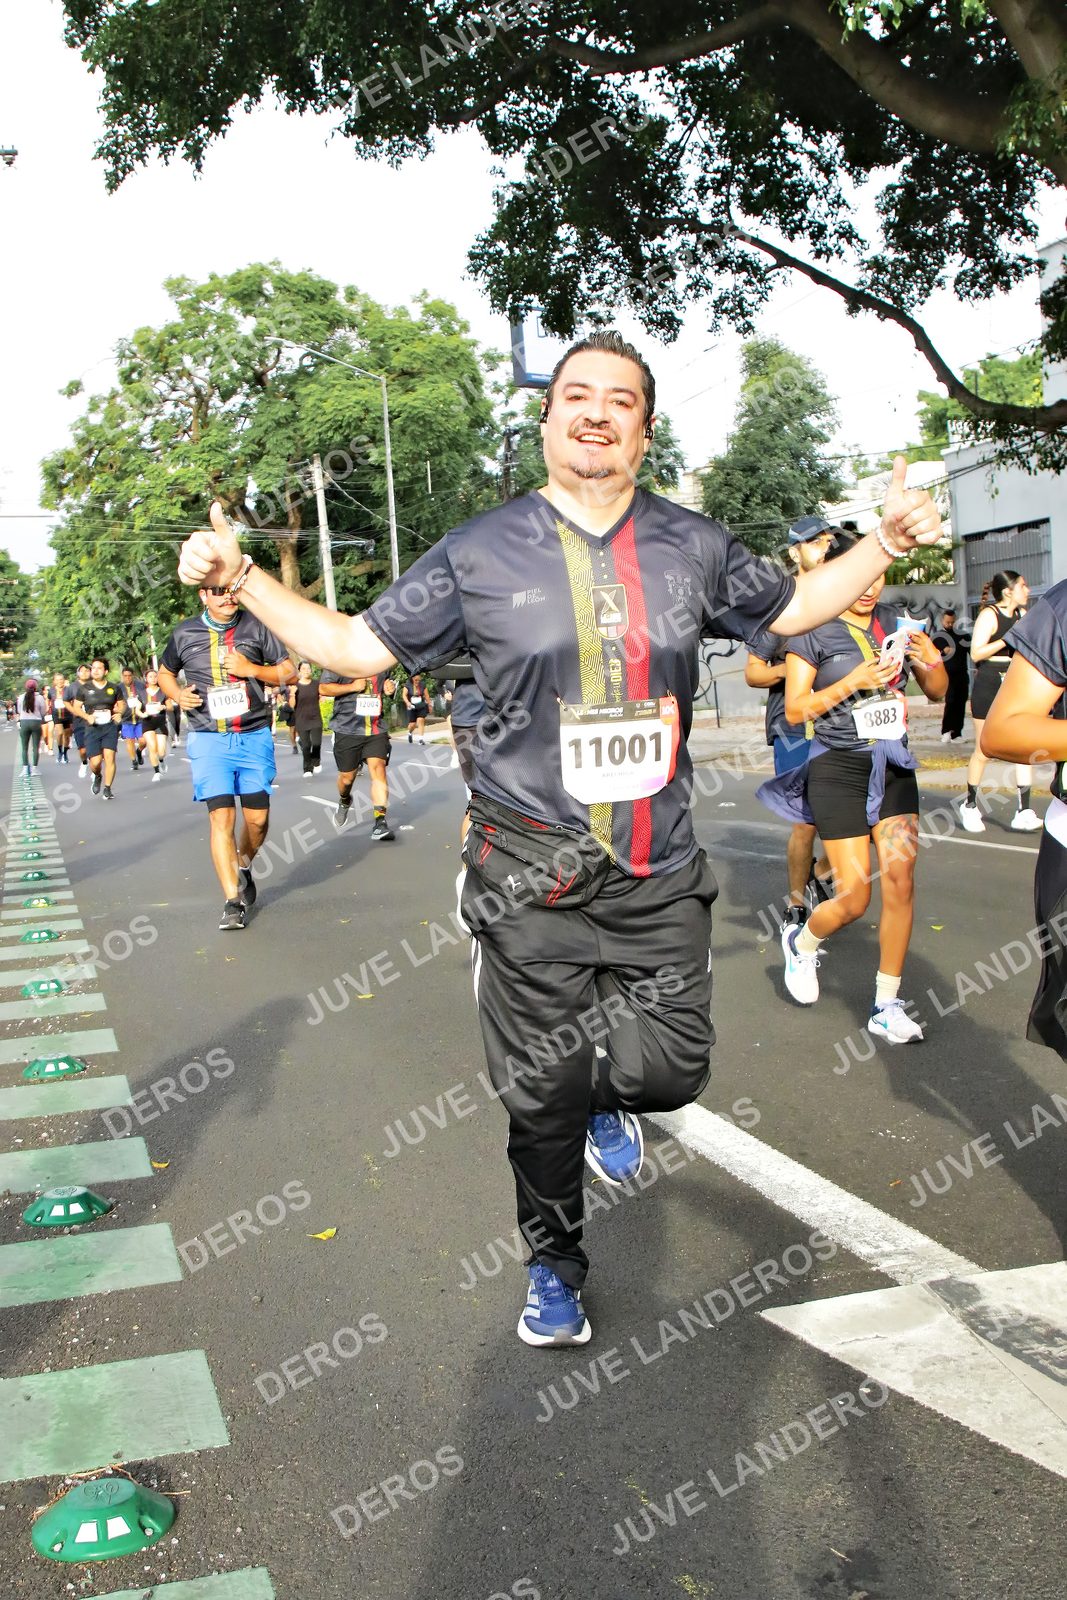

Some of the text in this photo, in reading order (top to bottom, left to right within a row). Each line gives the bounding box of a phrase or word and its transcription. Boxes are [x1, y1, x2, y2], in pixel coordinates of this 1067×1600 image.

[212, 692, 244, 707] 11082
[863, 707, 897, 727] 8883
[568, 731, 662, 769] 11001
